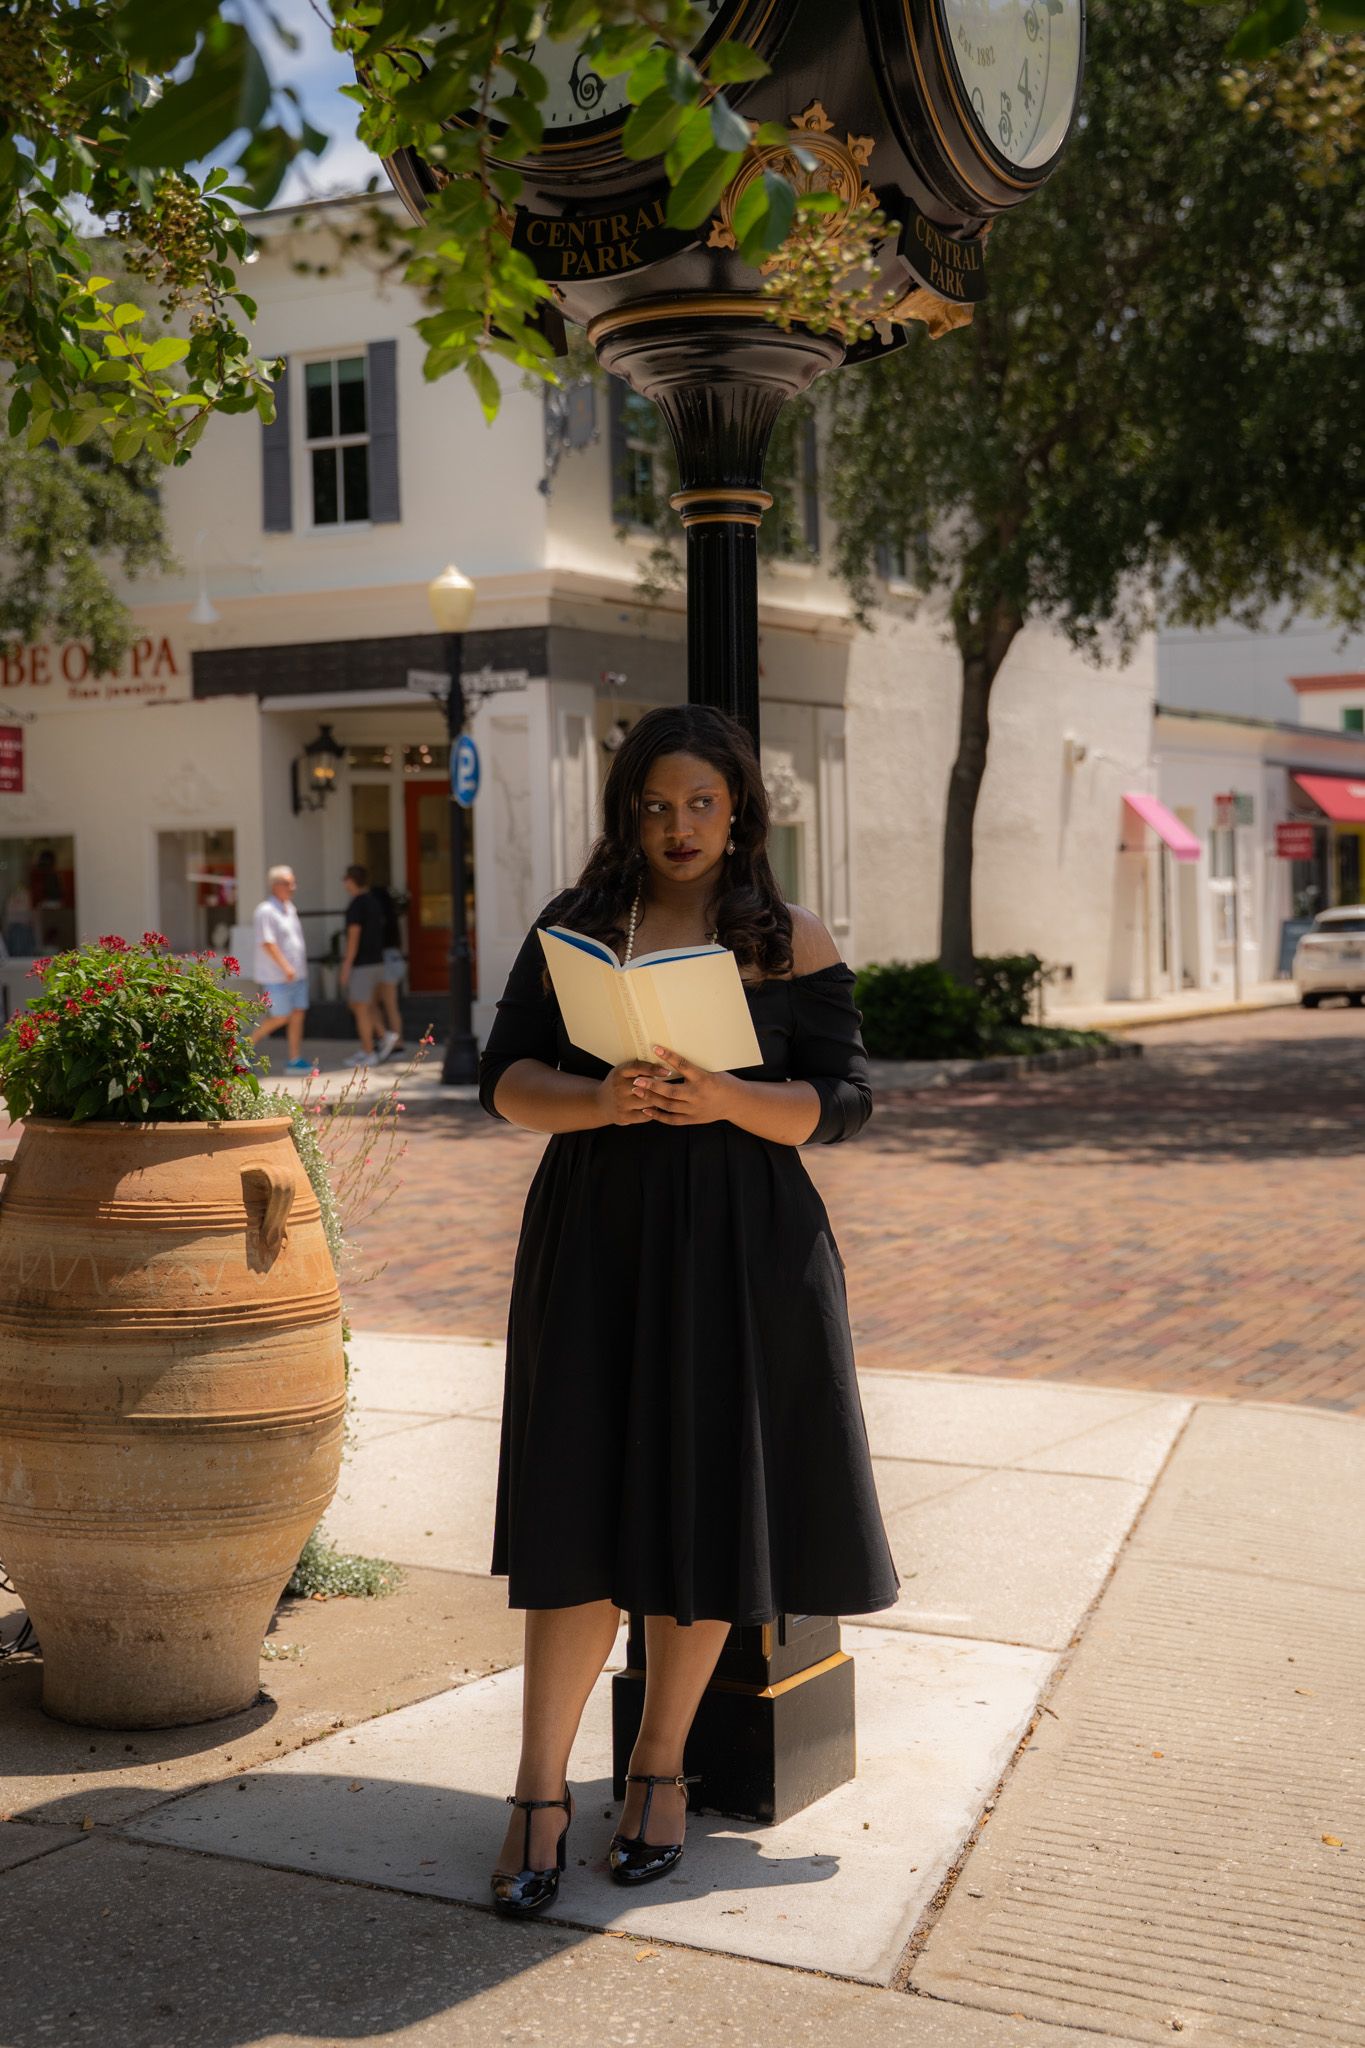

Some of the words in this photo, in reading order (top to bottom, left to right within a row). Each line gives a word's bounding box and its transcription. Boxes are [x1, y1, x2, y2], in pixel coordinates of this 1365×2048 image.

[958, 24, 974, 61] Est.
[976, 45, 996, 67] 1882
[568, 53, 607, 110] 6
[1017, 57, 1033, 110] 4
[999, 90, 1013, 147] 5
[560, 238, 644, 276] PARK
[915, 214, 980, 271] CENTRAL
[929, 256, 966, 298] PARK
